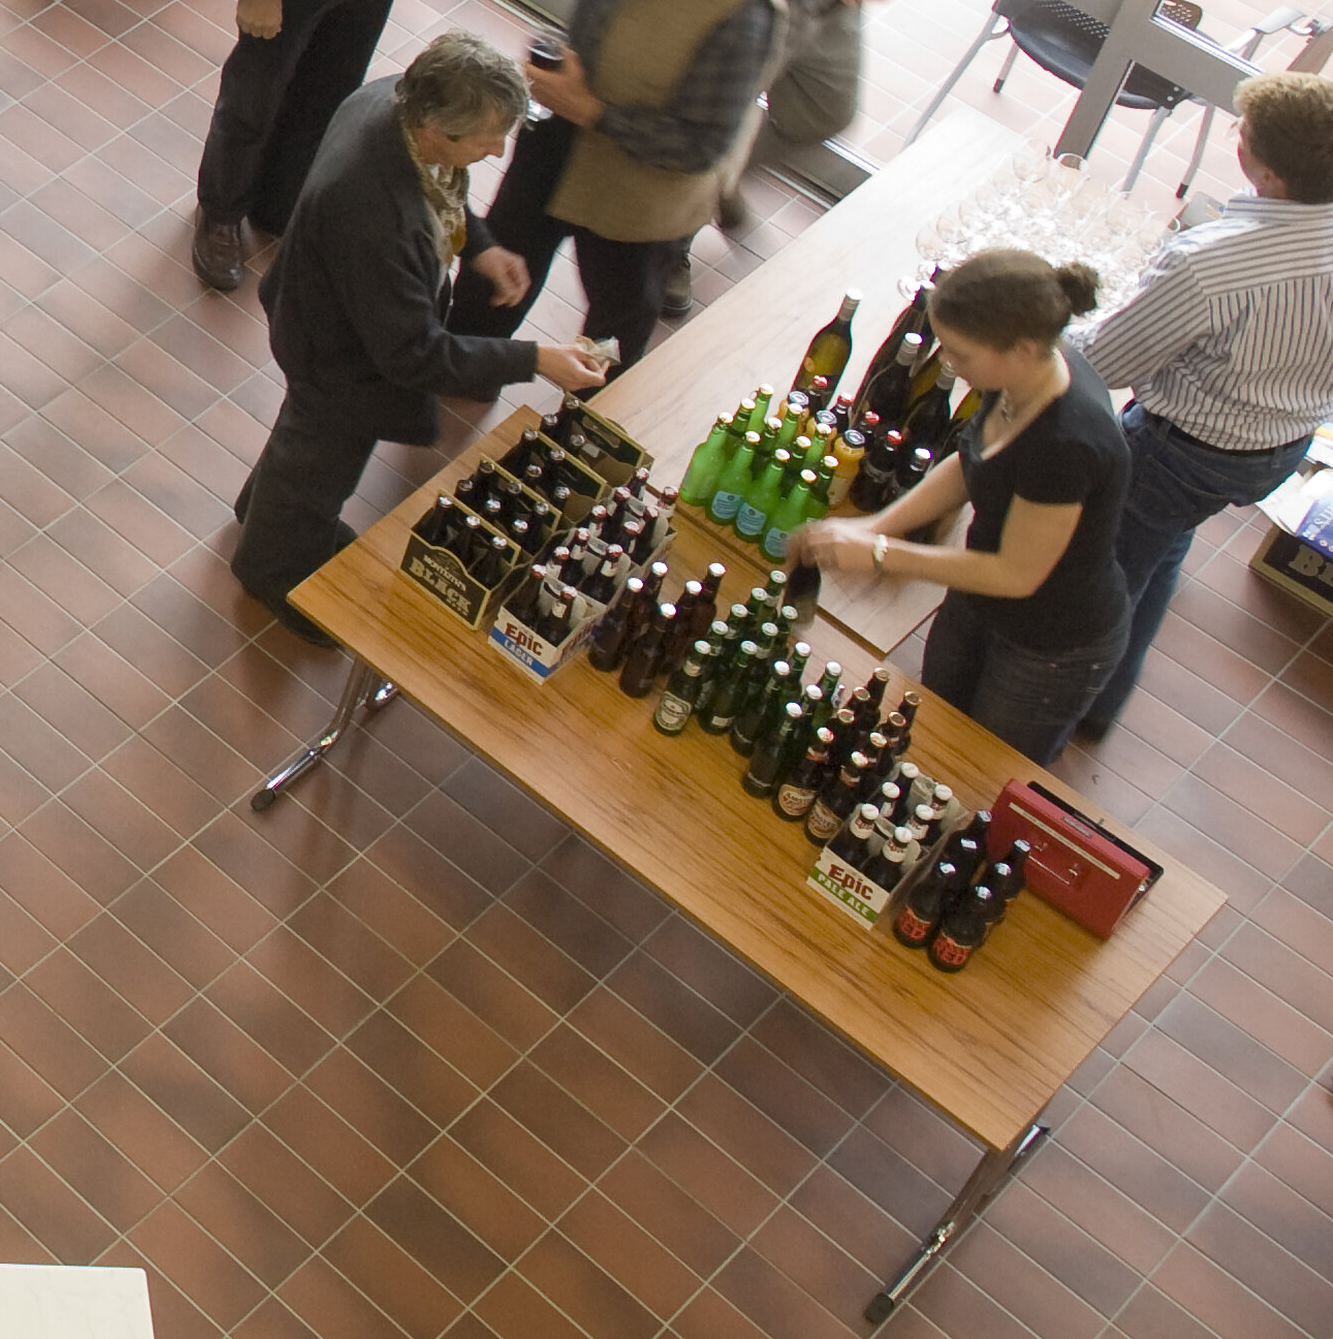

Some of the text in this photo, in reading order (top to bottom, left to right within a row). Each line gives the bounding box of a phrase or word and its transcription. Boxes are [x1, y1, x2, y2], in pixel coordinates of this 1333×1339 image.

[409, 556, 472, 614] BLACK
[503, 639, 534, 666] LAGER
[504, 622, 544, 657] Epic
[817, 874, 871, 917] PALE ALE
[828, 863, 874, 901] Epic
